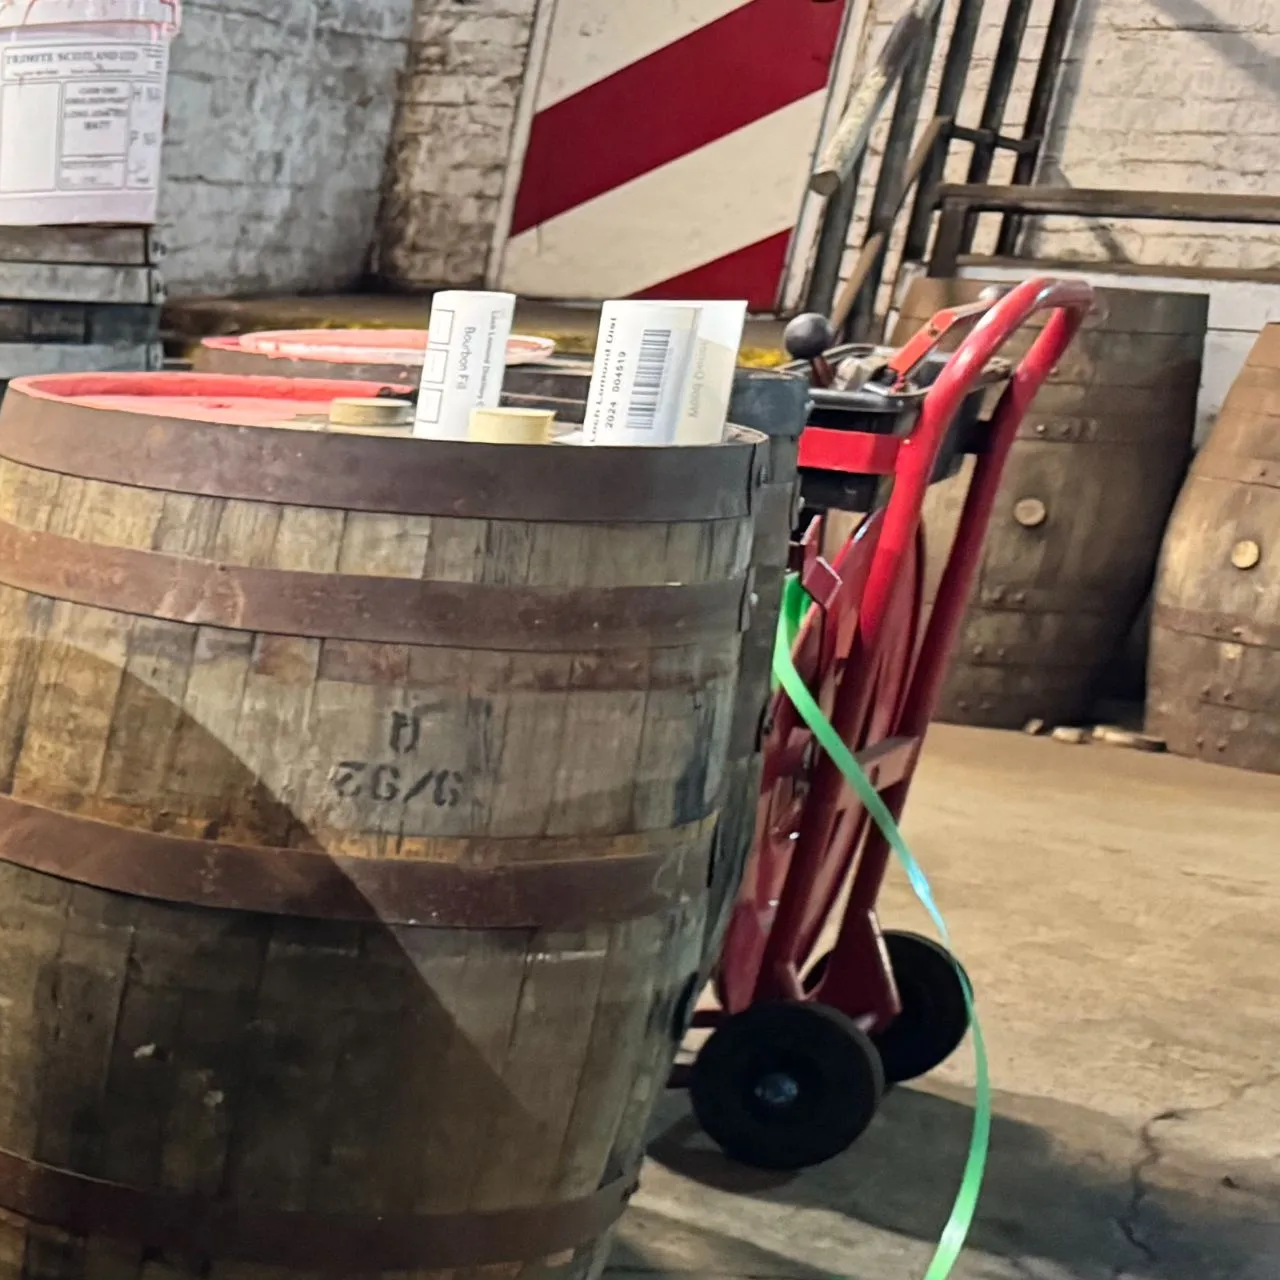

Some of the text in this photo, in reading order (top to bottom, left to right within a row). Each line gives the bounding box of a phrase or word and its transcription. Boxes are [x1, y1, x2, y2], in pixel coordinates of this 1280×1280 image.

[459, 326, 476, 371] Bourbon
[590, 409, 601, 442] Loch
[596, 348, 611, 405] Lomond
[605, 401, 617, 429] 2024
